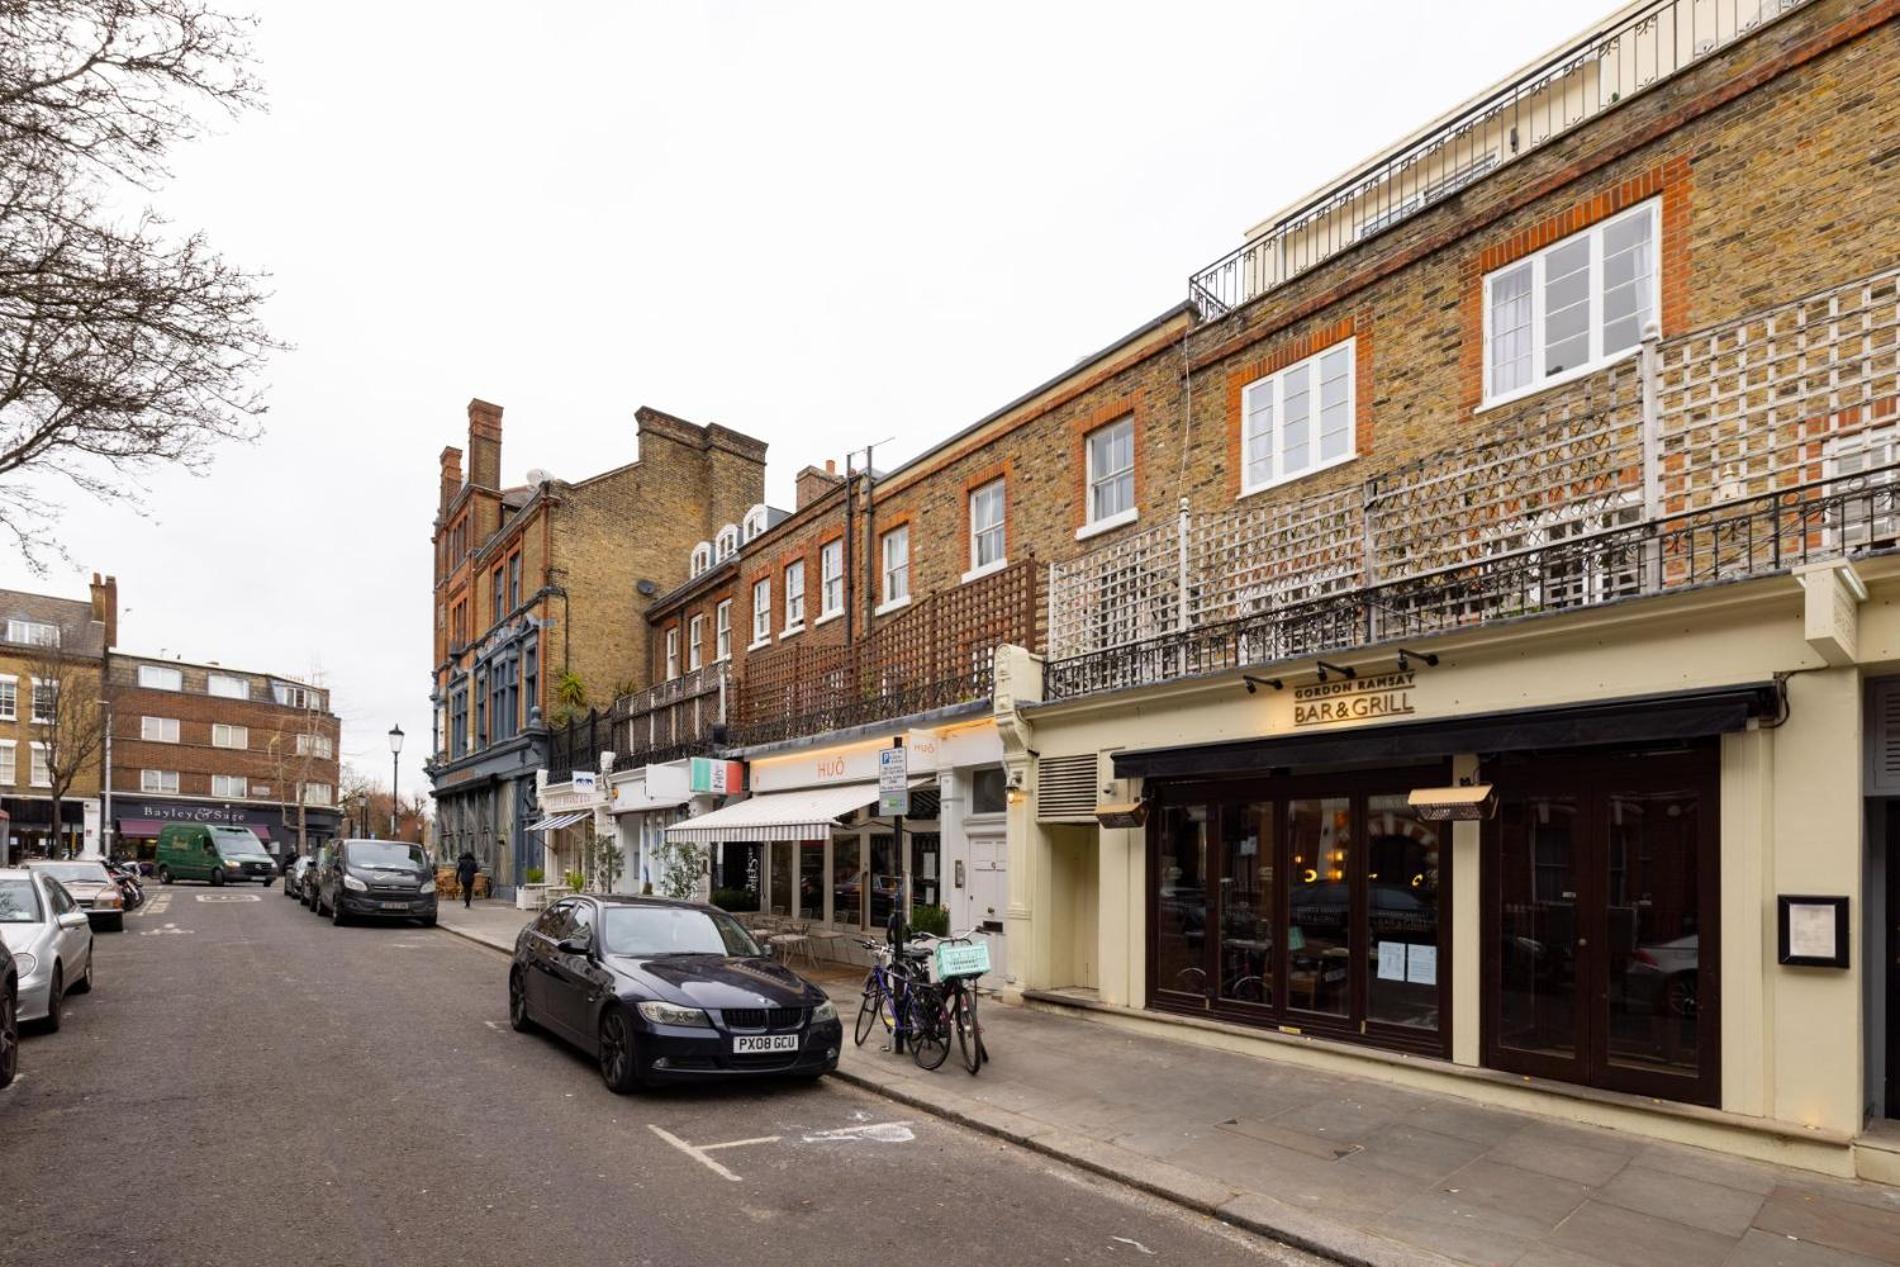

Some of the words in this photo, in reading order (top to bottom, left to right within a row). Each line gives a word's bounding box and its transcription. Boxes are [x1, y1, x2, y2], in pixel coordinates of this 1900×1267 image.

[1295, 683, 1352, 700] GORDON
[1358, 673, 1415, 690] RAMSAY
[144, 806, 192, 819] Bayley
[739, 1037, 771, 1050] PX08
[774, 1036, 795, 1049] GCU
